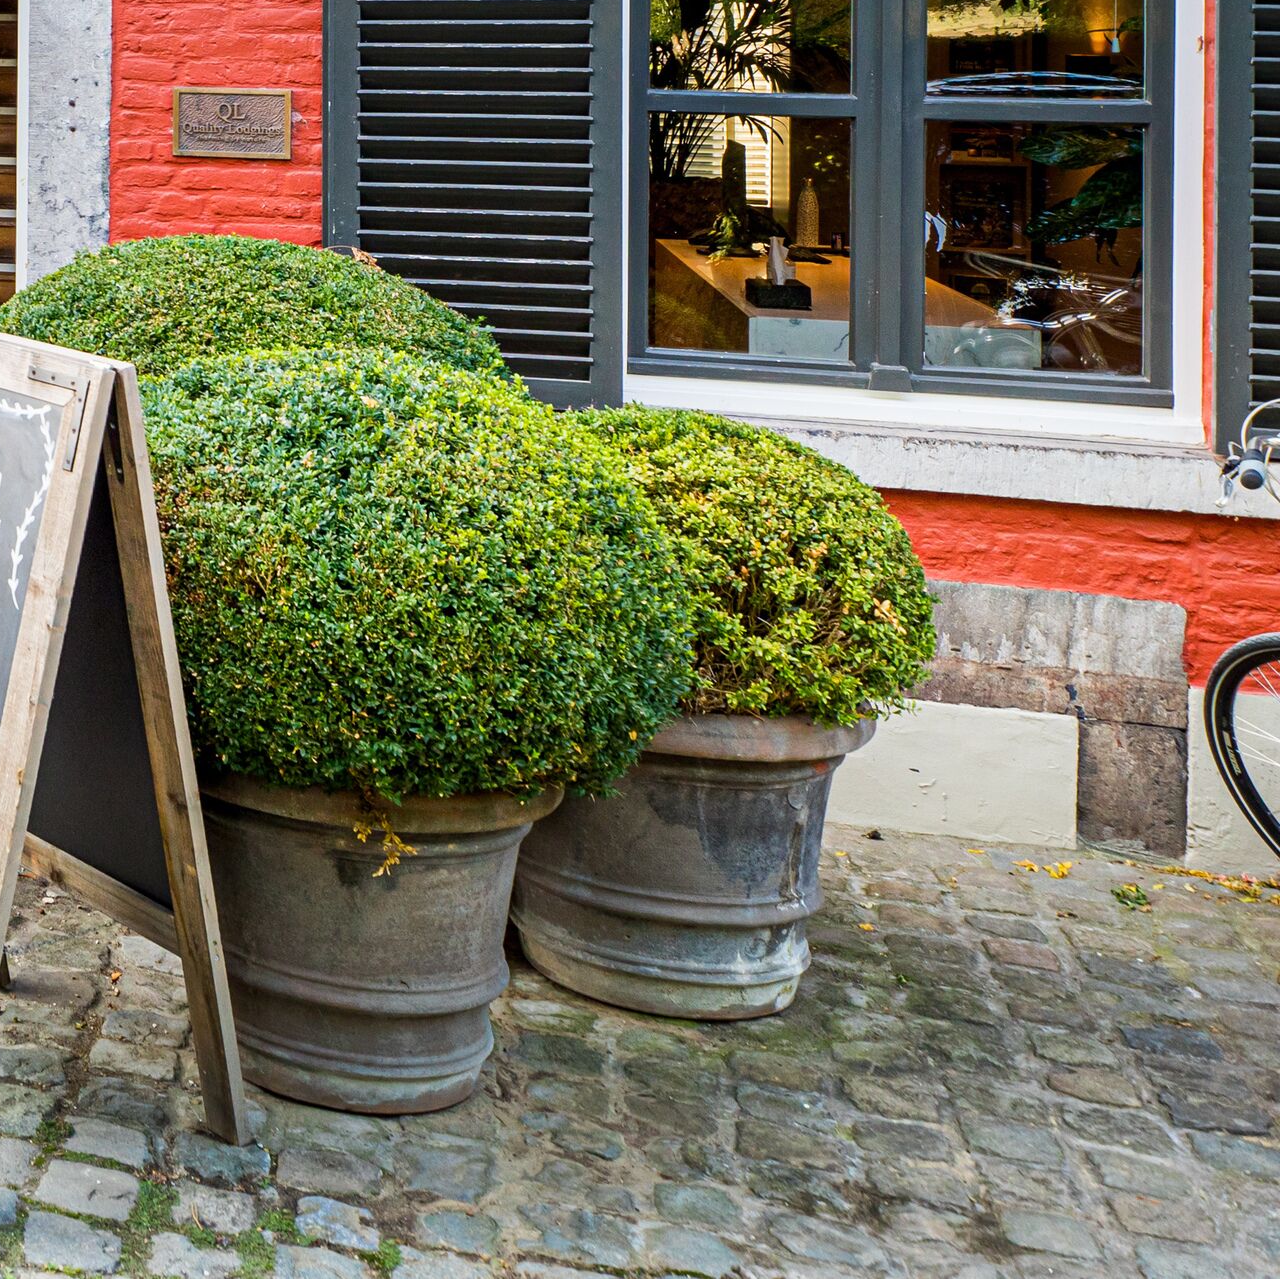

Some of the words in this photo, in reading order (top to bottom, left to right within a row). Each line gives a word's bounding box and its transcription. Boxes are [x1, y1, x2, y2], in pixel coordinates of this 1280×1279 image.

[217, 103, 246, 123] QL
[183, 122, 225, 136] Quality
[226, 124, 281, 138] Lodgings
